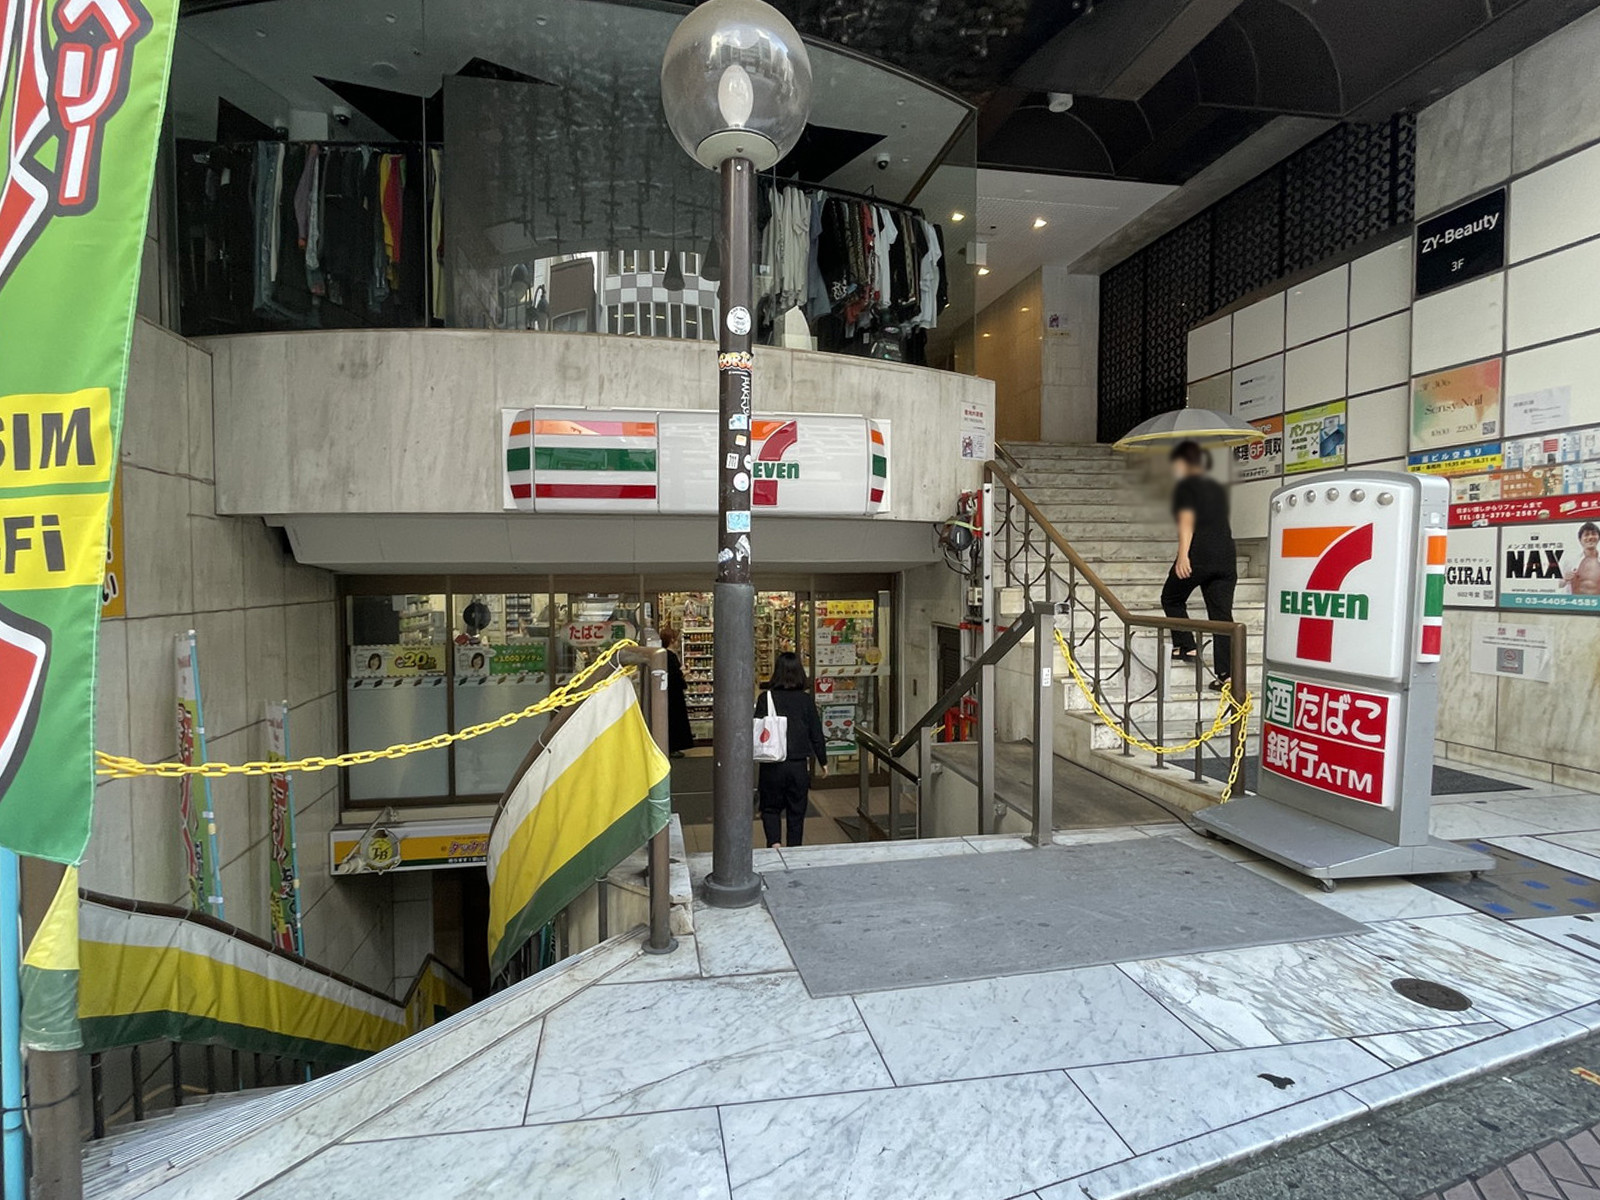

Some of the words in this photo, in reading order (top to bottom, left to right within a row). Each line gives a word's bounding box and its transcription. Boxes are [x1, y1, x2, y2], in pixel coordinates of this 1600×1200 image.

[1421, 211, 1500, 254] ZY-Beauty
[1450, 257, 1465, 272] 3F
[0, 406, 96, 471] IM
[1289, 421, 1322, 437] パソコン
[1250, 443, 1264, 458] 6F
[1264, 437, 1282, 457] 買取
[0, 514, 66, 574] Fi
[1444, 566, 1492, 586] GIRAI
[1506, 550, 1564, 579] NAX
[569, 624, 605, 640] たばこ
[1266, 679, 1293, 724] 酒
[1296, 686, 1382, 743] たばこ
[1266, 730, 1373, 794] 銀行ATM
